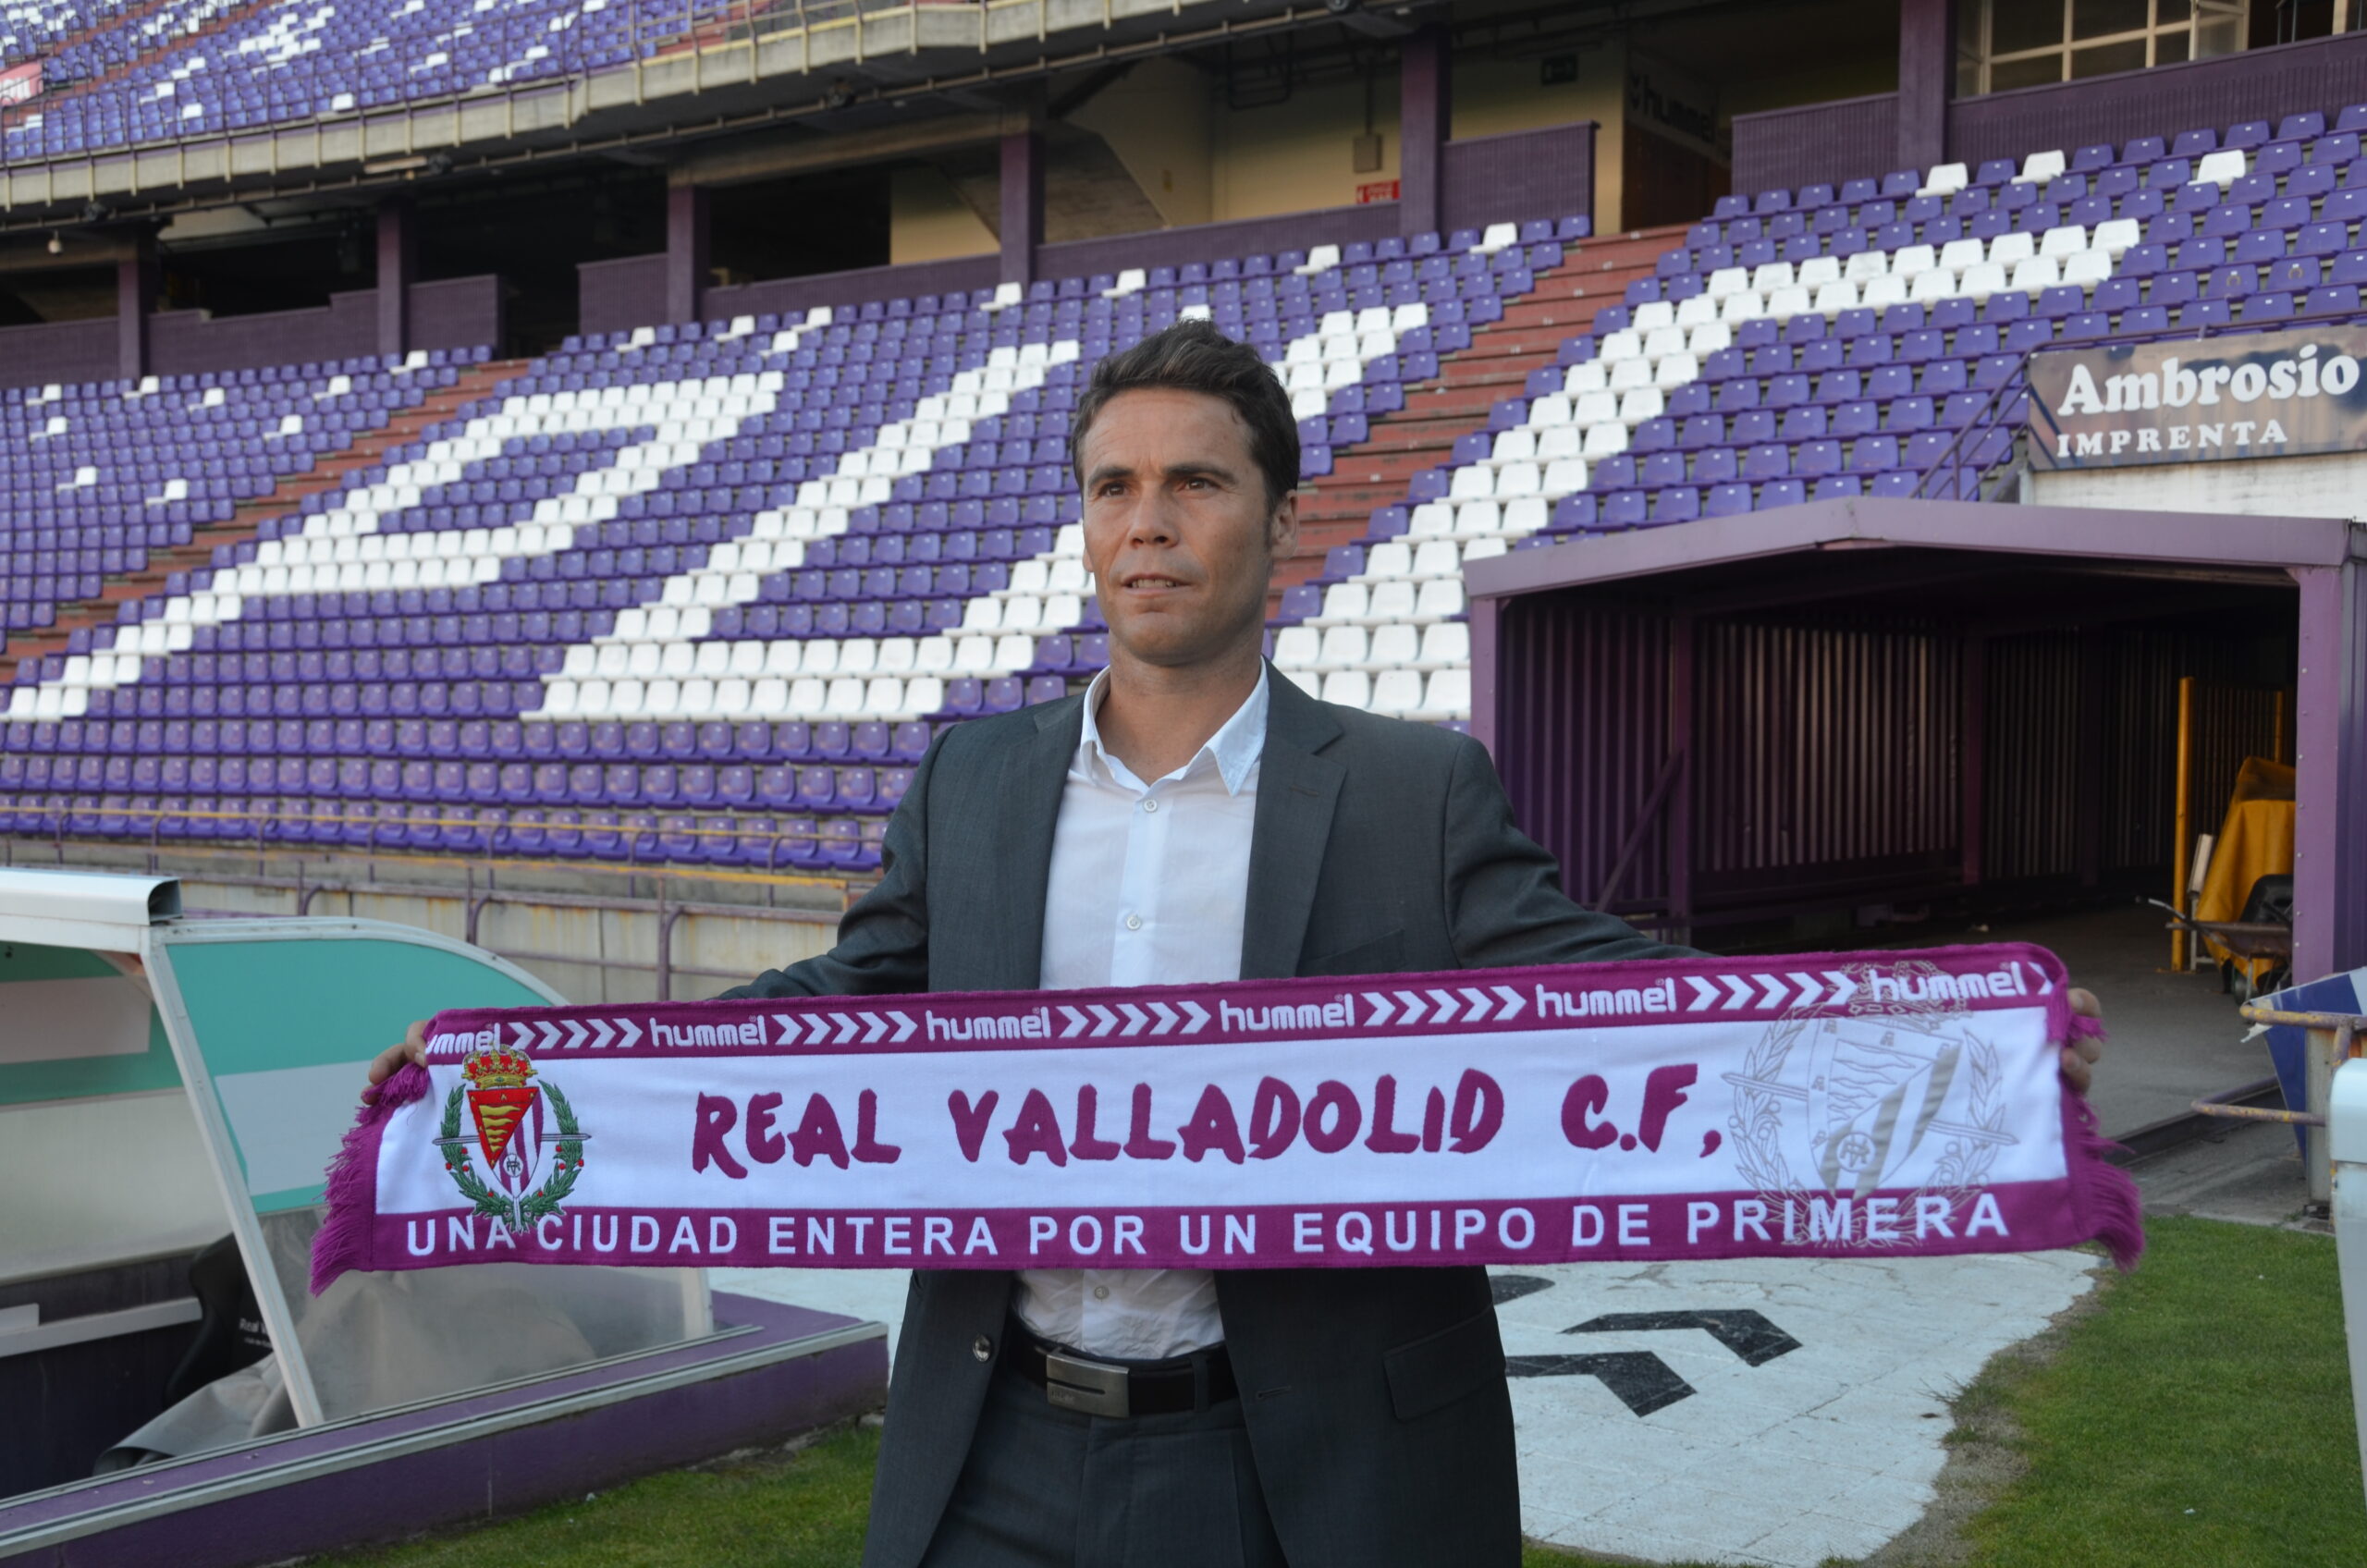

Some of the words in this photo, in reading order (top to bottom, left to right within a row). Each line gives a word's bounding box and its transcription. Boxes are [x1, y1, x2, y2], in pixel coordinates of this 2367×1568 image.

[2057, 344, 2361, 416] Ambrosio
[2057, 419, 2288, 458] IMPRENTA
[650, 1014, 767, 1047] hummel
[926, 1007, 1051, 1041] hummel
[1220, 993, 1355, 1032] hummel
[1536, 977, 1676, 1018] hummel
[1869, 962, 2027, 1002] hummel
[693, 1087, 901, 1179] REAL
[948, 1068, 1504, 1168] VALLADOLID
[408, 1213, 516, 1256] UNA
[537, 1213, 737, 1254] CIUDAD
[768, 1216, 999, 1256] ENTERA
[1029, 1214, 1147, 1256] POR
[1180, 1214, 1256, 1256] UN
[1294, 1208, 1536, 1256] EQUIPO
[1573, 1204, 1650, 1247] DE
[1687, 1193, 2009, 1244] PRIMERA
